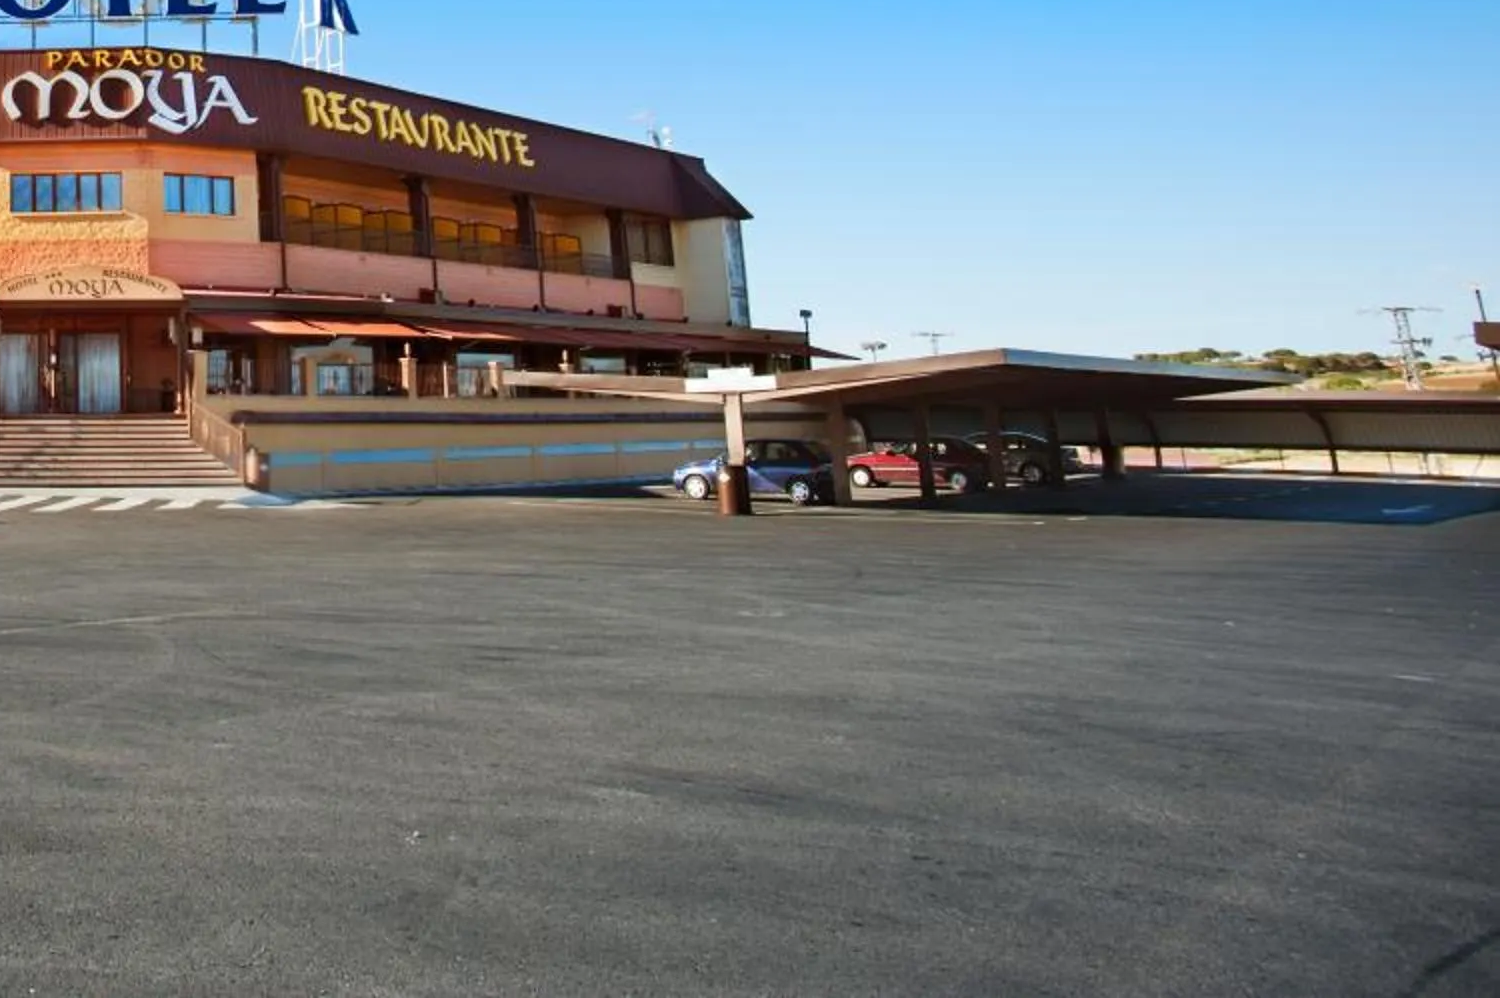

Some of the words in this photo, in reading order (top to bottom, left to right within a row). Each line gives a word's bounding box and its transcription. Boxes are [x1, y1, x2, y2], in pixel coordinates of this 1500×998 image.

[46, 49, 206, 73] PARADOR
[2, 69, 259, 134] MOYA
[7, 276, 38, 292] HOTEL
[49, 279, 124, 298] MOYA
